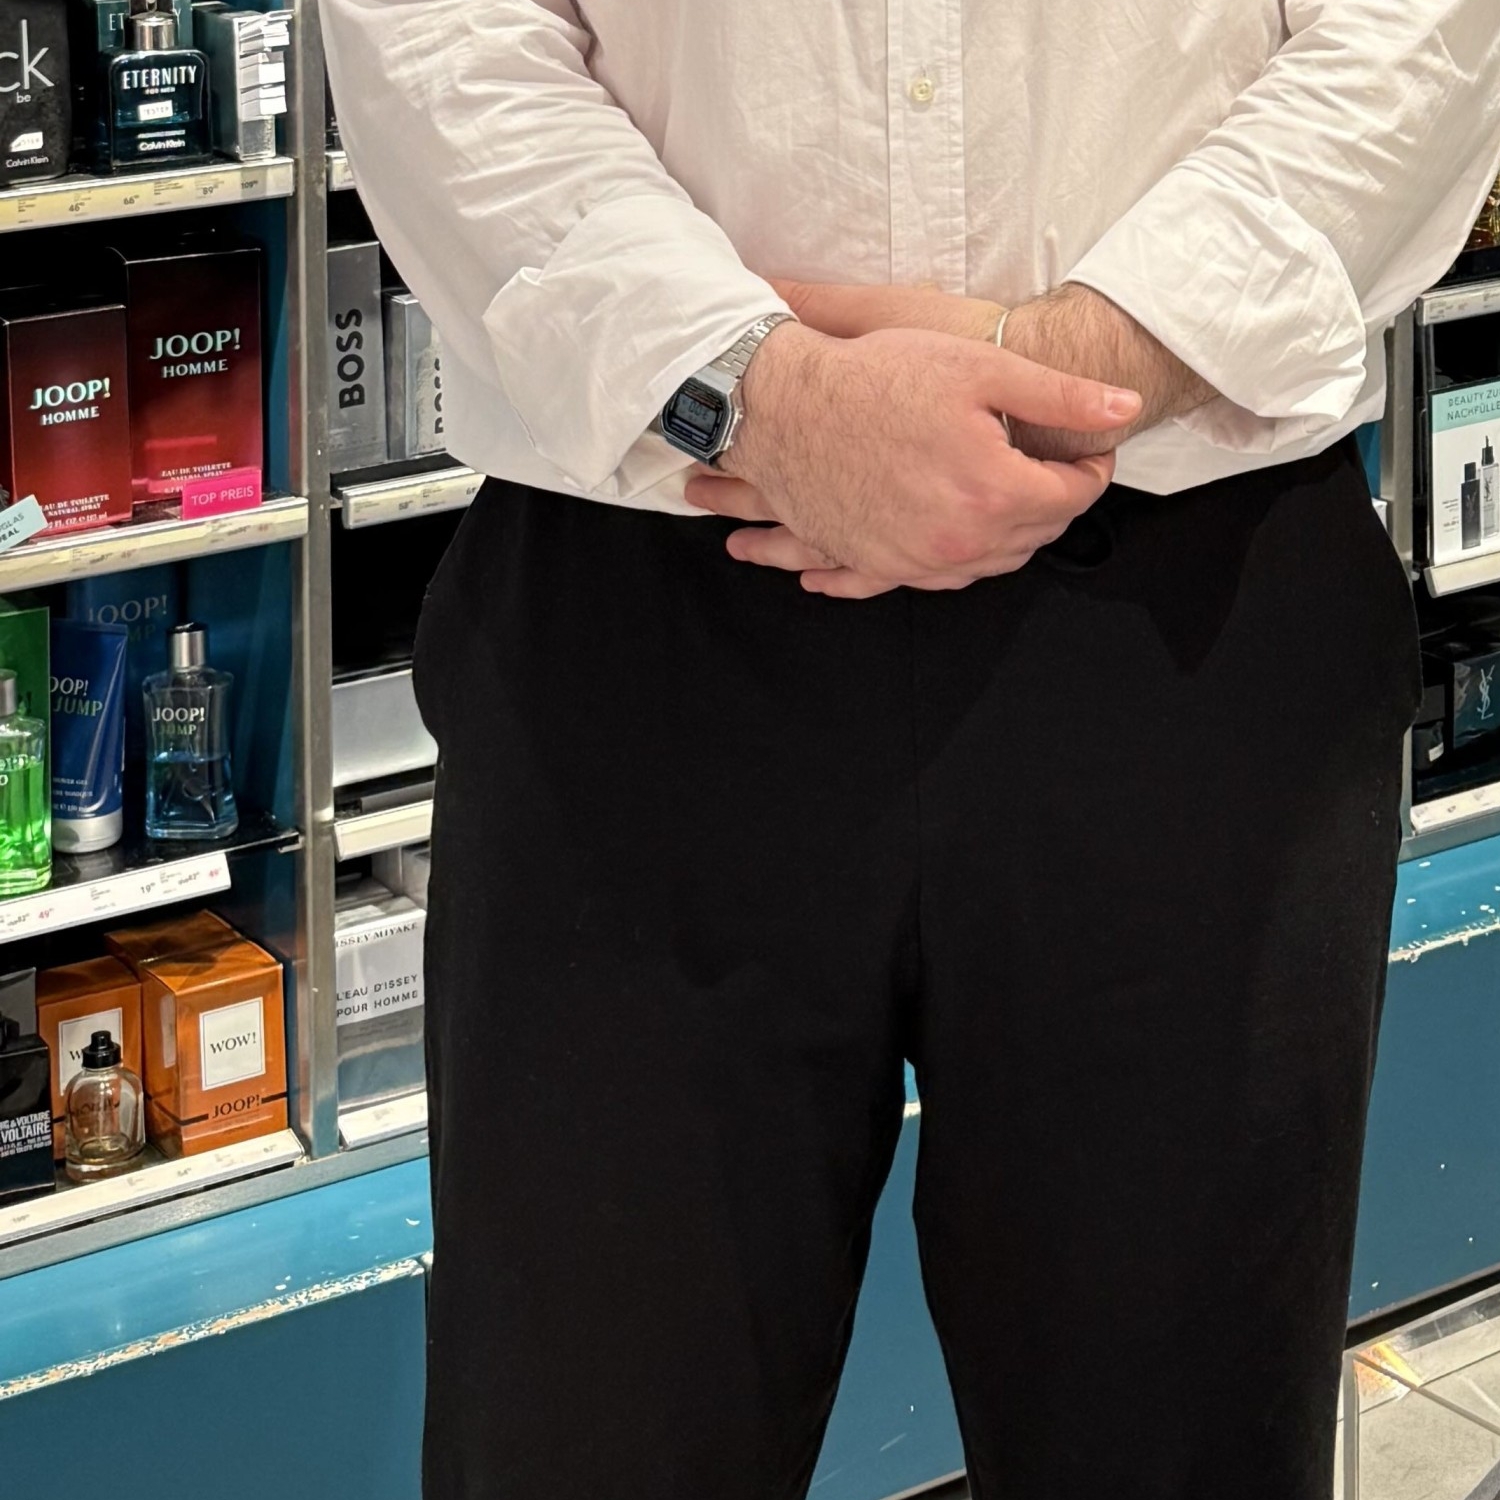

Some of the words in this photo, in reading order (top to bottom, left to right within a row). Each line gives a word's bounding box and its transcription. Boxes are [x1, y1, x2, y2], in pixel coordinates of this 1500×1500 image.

[0, 19, 55, 93] ck
[121, 66, 197, 90] ETERNITY
[17, 92, 31, 103] be
[138, 141, 162, 151] Calvin
[162, 140, 185, 149] Klein
[6, 158, 29, 168] Calvin
[29, 156, 49, 164] Klein
[150, 327, 241, 361] JOOP!
[162, 359, 228, 378] HOMME
[335, 308, 365, 410] BOSS
[30, 377, 111, 411] JOOP!
[1448, 392, 1485, 408] BEAUTY
[40, 405, 100, 426] HOMME
[162, 469, 179, 478] EAU
[193, 462, 232, 473] TOILETTE
[70, 494, 109, 507] TOILETTE
[192, 494, 216, 506] TOP
[220, 486, 254, 501] PREIS
[54, 697, 103, 717] JUMP
[153, 707, 205, 722] JOOP!
[159, 725, 197, 736] JUMP
[336, 932, 371, 947] ISSEY
[374, 922, 417, 939] MIYAKE
[336, 986, 368, 1001] L'EAU
[374, 974, 417, 993] D'ISSEY
[337, 1003, 368, 1018] POUR
[374, 990, 418, 1008] HOMME
[209, 1031, 258, 1055] WOW!
[211, 1094, 261, 1120] JOOP!
[16, 1110, 50, 1125] VOLTAIRE
[1, 1121, 51, 1143] VOLTAIRE
